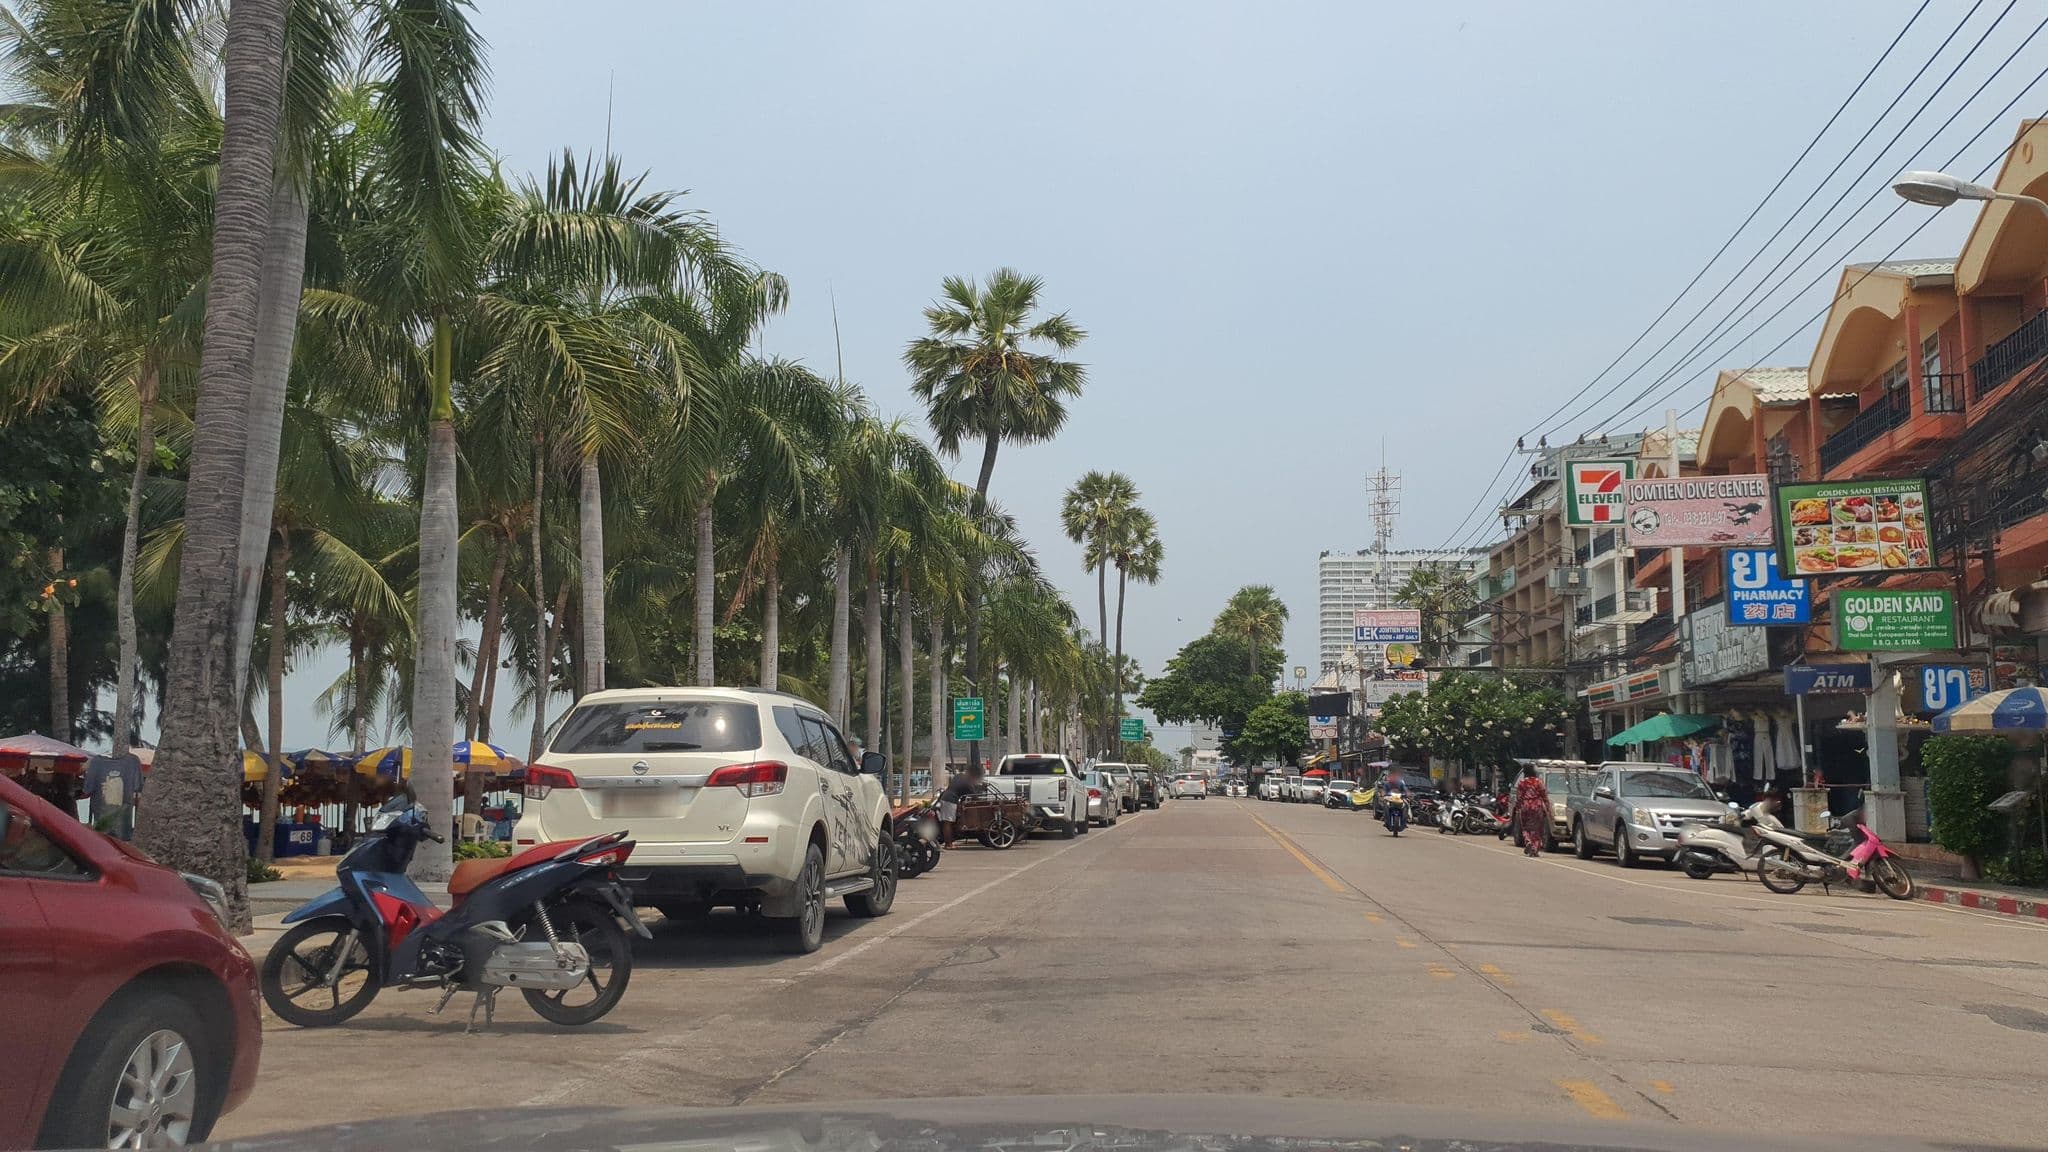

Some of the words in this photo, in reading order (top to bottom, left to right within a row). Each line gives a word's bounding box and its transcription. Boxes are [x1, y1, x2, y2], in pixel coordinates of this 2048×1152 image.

[1580, 470, 1621, 523] 7
[1629, 483, 1685, 505] JOMTIEN
[1686, 482, 1717, 500] DIVE
[1718, 480, 1765, 498] CENTER
[1817, 489, 1848, 497] GOLDEN
[1850, 487, 1871, 495] SAND
[1873, 484, 1921, 494] RESTAURANT
[1733, 589, 1804, 601] PHARMACY
[1845, 597, 1902, 614] GOLDEN
[1905, 596, 1944, 613] SAND
[1881, 615, 1936, 623] RESTAURANT
[1357, 627, 1379, 640] LEK
[1813, 675, 1855, 688] ATM
[1925, 668, 1967, 710] ยา
